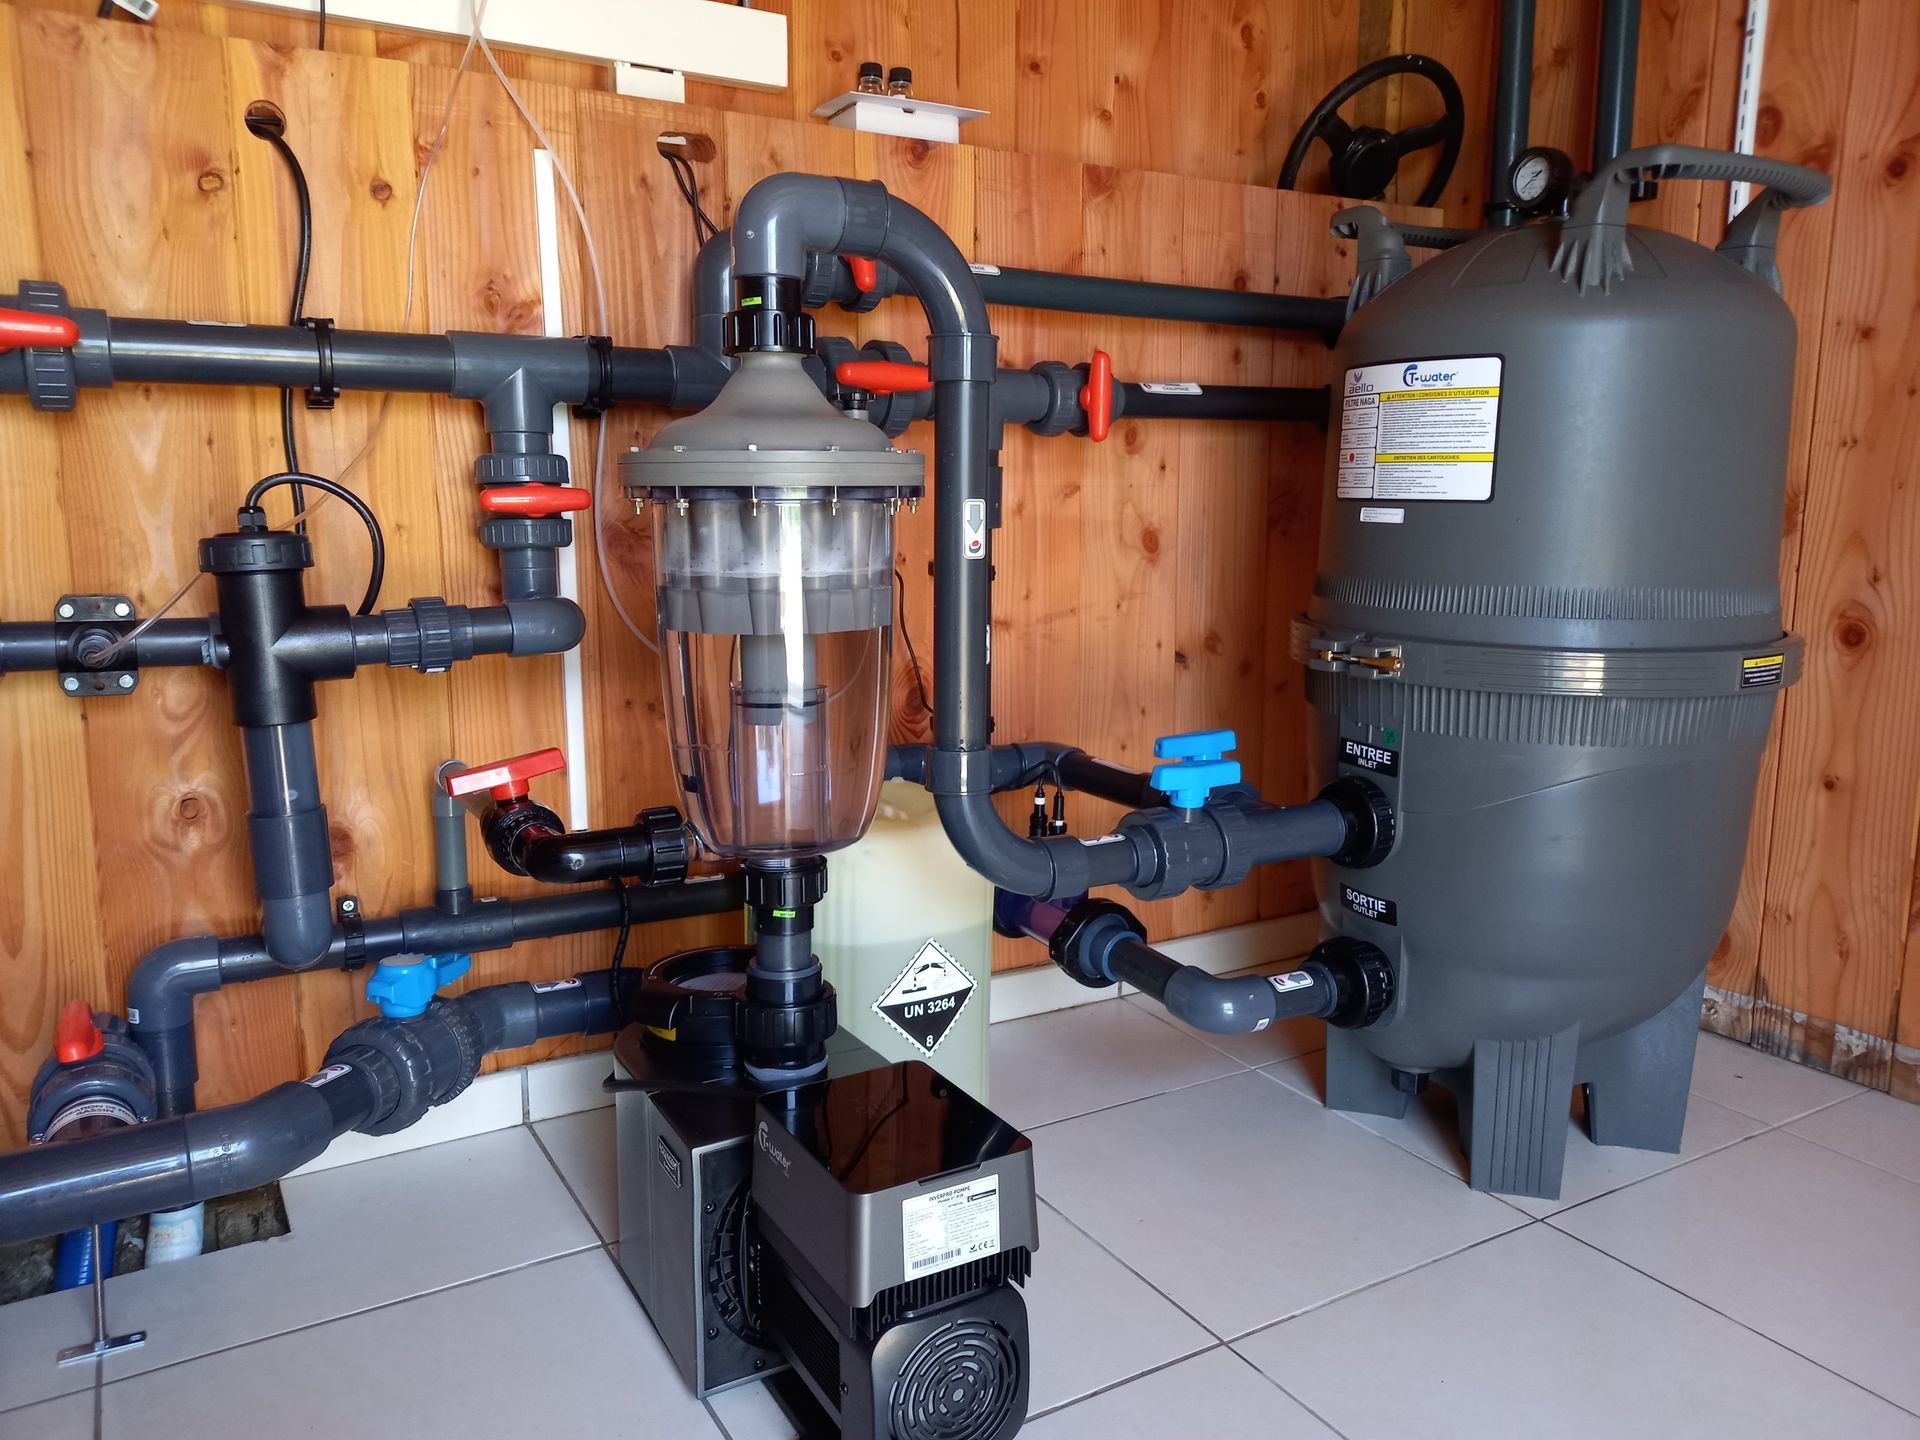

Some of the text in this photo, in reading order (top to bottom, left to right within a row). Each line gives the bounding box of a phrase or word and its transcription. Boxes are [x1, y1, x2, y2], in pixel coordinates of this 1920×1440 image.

[1346, 741, 1392, 765] ENTREE
[1358, 757, 1377, 769] INLET
[1346, 888, 1387, 913] SORTIE
[1352, 903, 1378, 918] OUTLET
[904, 995, 956, 1018] UN 3264
[926, 1034, 934, 1047] 8
